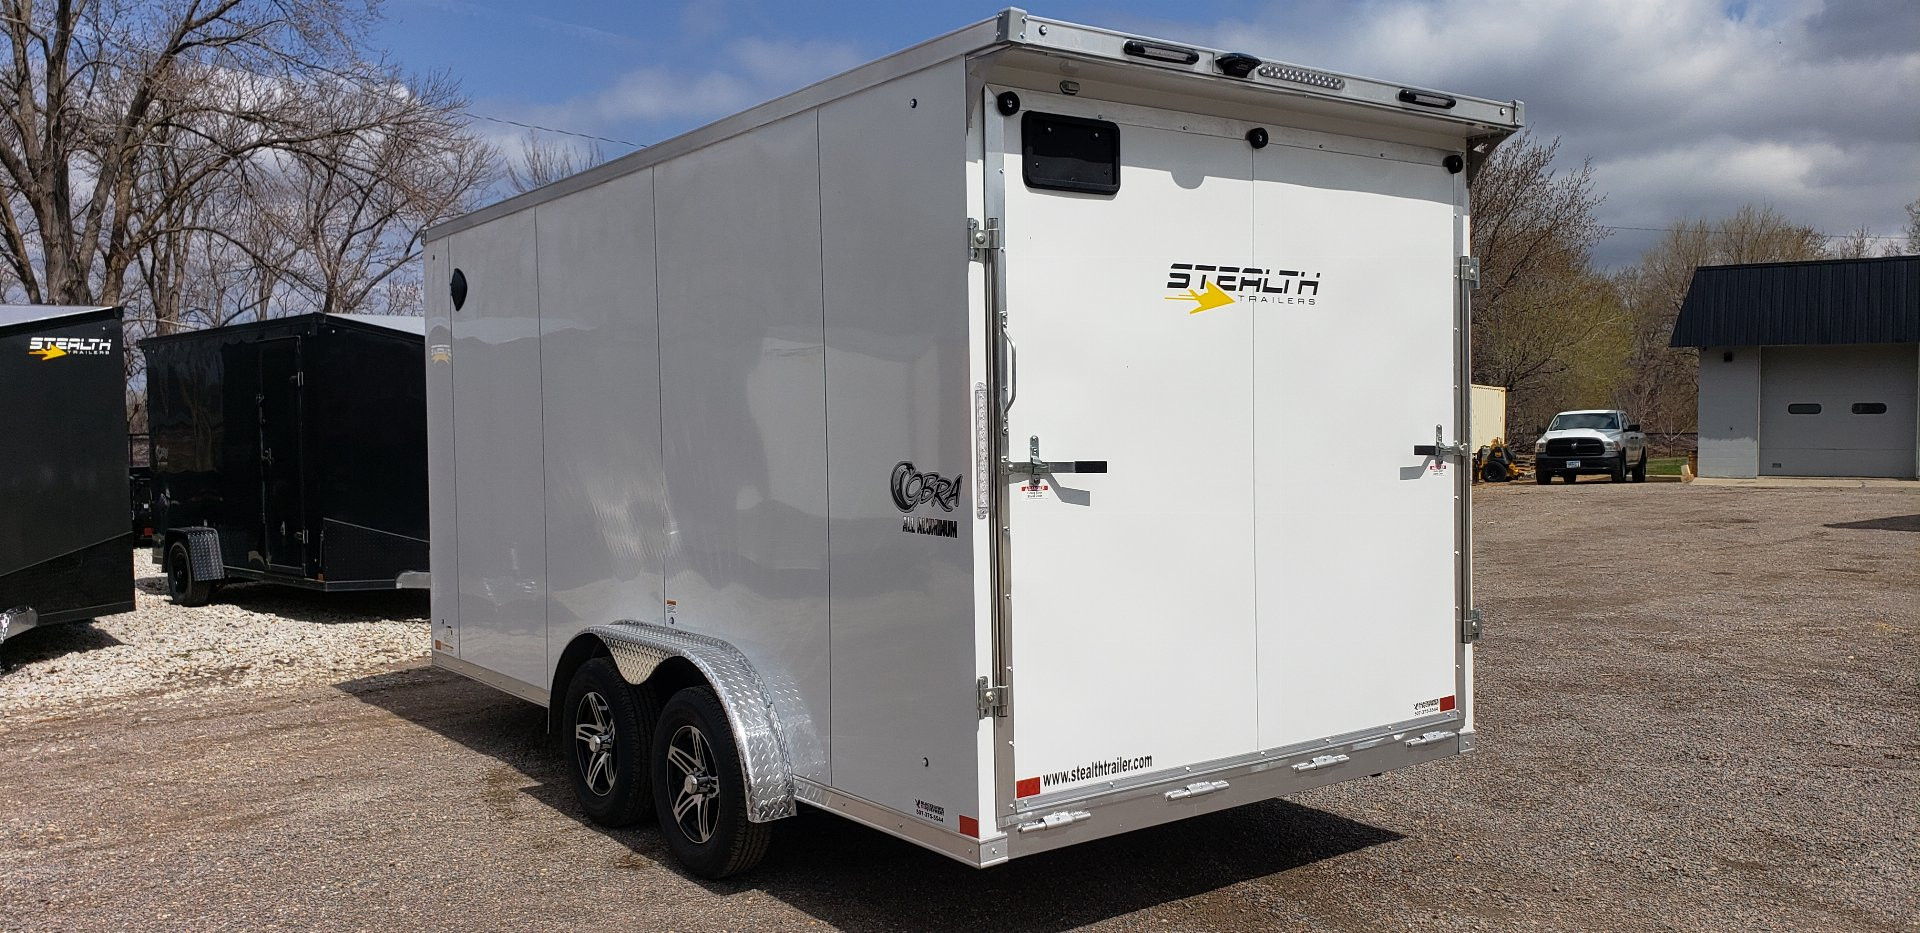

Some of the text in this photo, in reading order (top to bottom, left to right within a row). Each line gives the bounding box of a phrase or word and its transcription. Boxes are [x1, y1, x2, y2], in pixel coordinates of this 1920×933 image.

[1166, 263, 1321, 296] STEALTH
[1237, 294, 1317, 306] TRAILERS
[29, 336, 112, 351] STEALTH
[902, 515, 958, 538] ALL ALUMINUM
[1042, 754, 1153, 787] www.stealthtrailer.com
